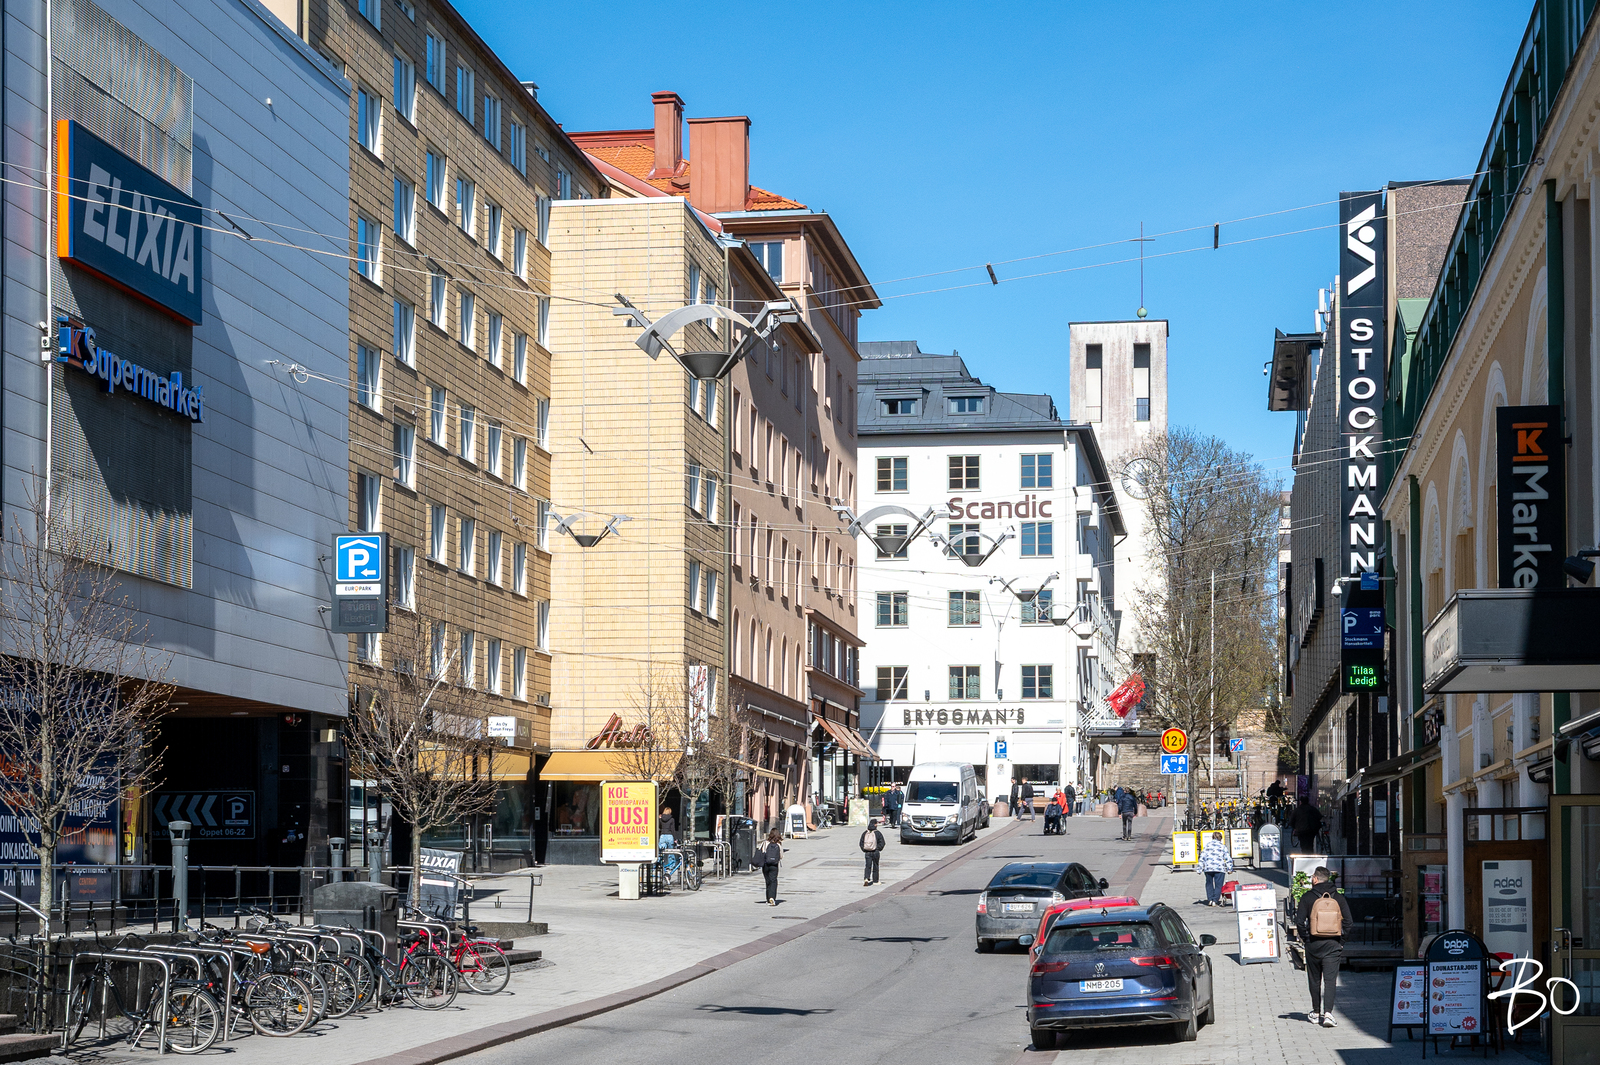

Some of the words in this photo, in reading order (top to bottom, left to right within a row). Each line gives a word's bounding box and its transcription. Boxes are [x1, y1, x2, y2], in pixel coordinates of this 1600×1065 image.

[83, 163, 194, 294] ELIXIA
[83, 327, 205, 423] Supermarket
[1348, 318, 1376, 574] STOCKMANN
[948, 494, 1052, 520] Scandic
[1351, 666, 1374, 675] Tilaa
[1350, 676, 1377, 687] Ledigt
[903, 707, 1025, 726] BRYGGMAN'S
[608, 787, 629, 798] KOE
[608, 807, 649, 825] UUSI
[88, 828, 114, 845] JUOMIA
[200, 829, 223, 839] Öppet
[608, 826, 649, 834] AIKAKAUSI
[0, 843, 38, 860] JOKAISENA
[420, 855, 456, 869] ELIXIA
[1086, 980, 1121, 989] NMB-205
